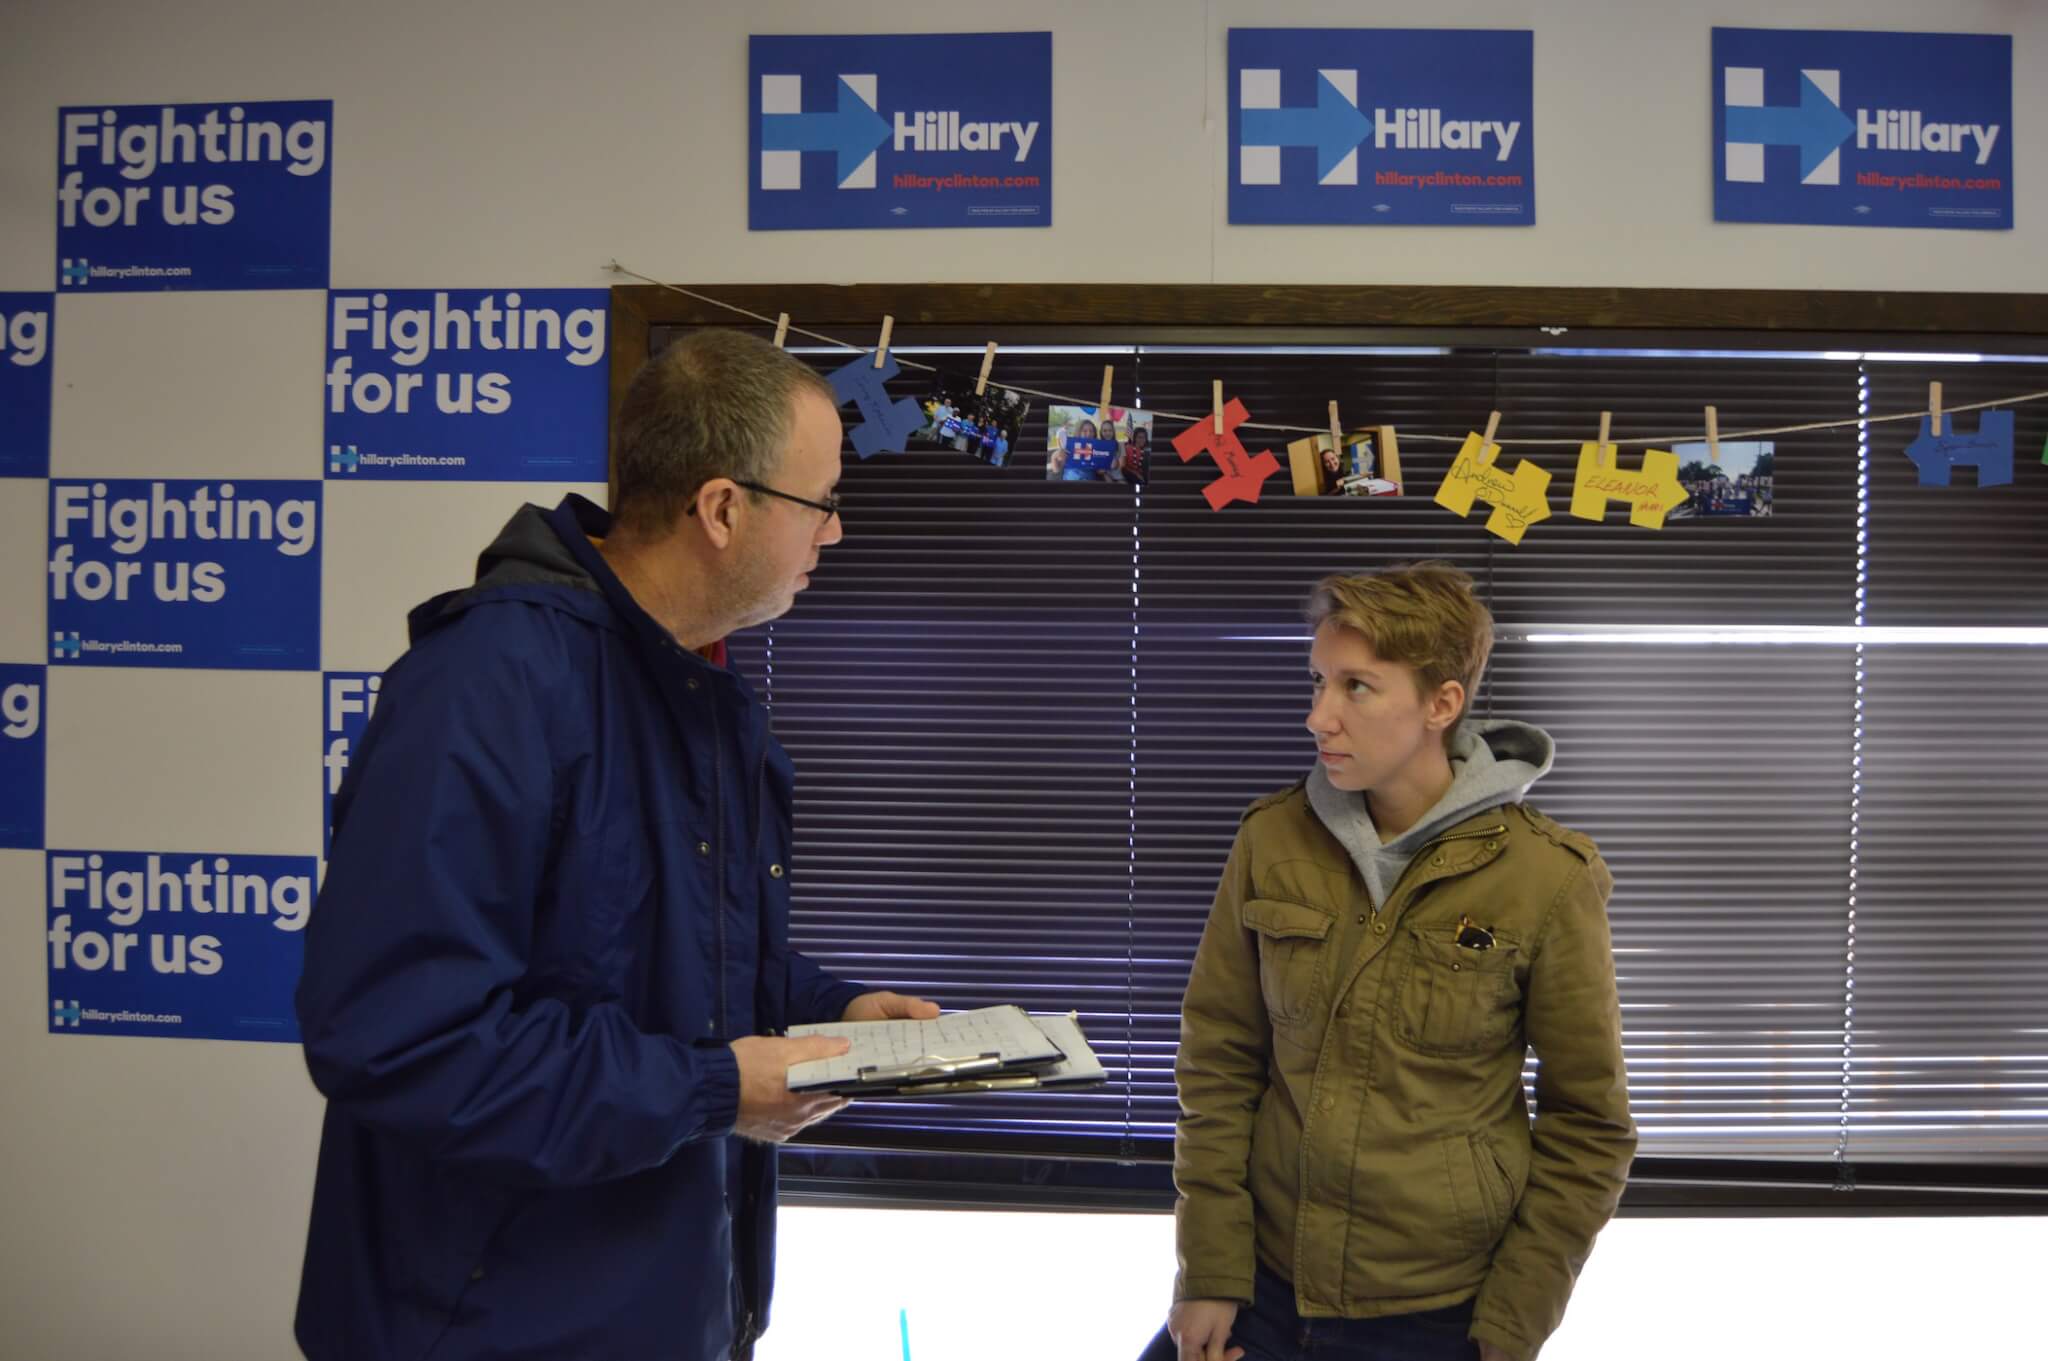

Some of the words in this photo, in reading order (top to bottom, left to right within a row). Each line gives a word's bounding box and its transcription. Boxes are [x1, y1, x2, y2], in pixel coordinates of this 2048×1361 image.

[64, 107, 326, 180] Fighting
[893, 111, 1039, 162] Hillary
[1374, 108, 1521, 161] Hillary
[1856, 108, 2000, 165] Hillary
[59, 171, 150, 227] for
[162, 184, 235, 226] us
[893, 174, 1040, 192] hillaryclinton.com
[1375, 171, 1522, 189] hillaryclinton.com
[1856, 171, 2001, 191] hillaryclinton.com
[89, 265, 192, 279] hillaryclinton.com
[332, 293, 607, 367] Fighting
[327, 356, 424, 414] for
[436, 372, 512, 414] us
[359, 453, 466, 467] hillaryclinton.com
[1451, 457, 1515, 492] Andrew
[1583, 475, 1660, 498] ELEANOR
[53, 483, 317, 557] Fighting
[48, 544, 142, 601] for
[154, 561, 226, 603] us
[81, 639, 183, 654] hillaryclinton.com
[51, 854, 312, 931] Fighting
[48, 914, 139, 973] for
[150, 934, 223, 975] us
[81, 1008, 182, 1024] hillaryclinton.com
